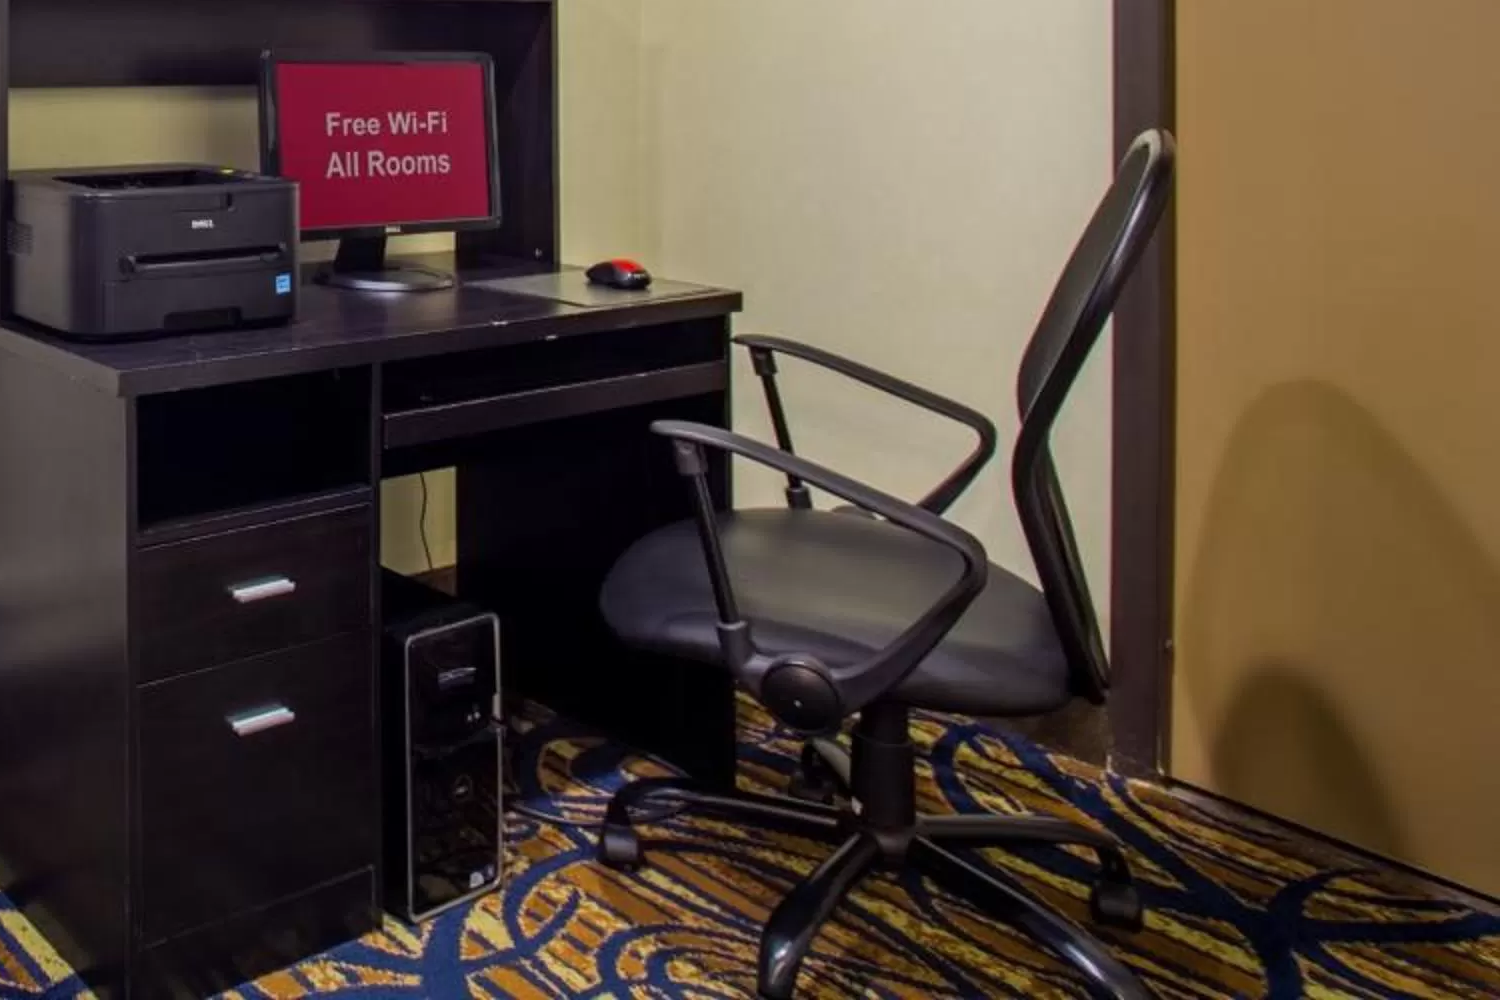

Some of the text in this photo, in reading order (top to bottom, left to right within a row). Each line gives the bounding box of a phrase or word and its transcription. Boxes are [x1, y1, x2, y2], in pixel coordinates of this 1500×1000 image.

[325, 110, 448, 136] Free Wi-Fi
[325, 150, 452, 178] All Rooms
